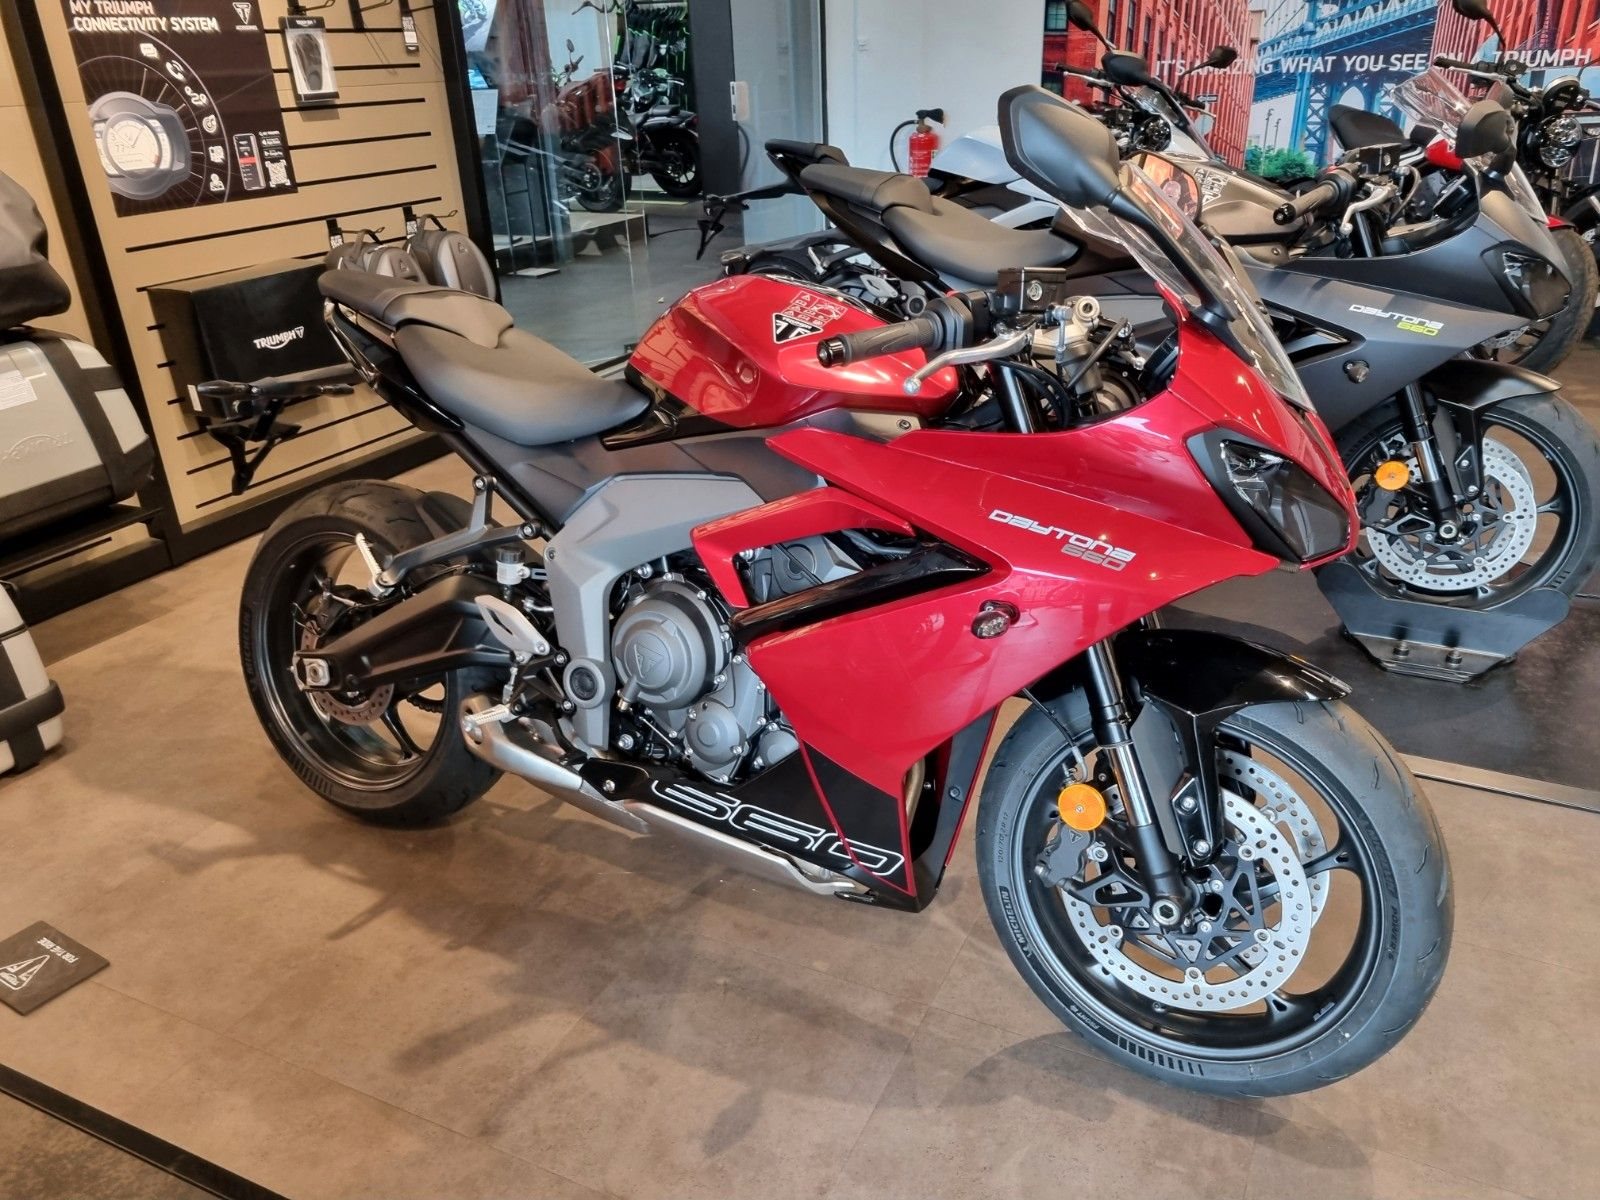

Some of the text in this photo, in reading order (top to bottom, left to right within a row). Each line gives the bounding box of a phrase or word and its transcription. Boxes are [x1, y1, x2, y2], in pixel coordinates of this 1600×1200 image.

[69, 0, 155, 15] MY TRIUMPH
[73, 17, 168, 31] CONNECTIVITY
[170, 17, 220, 31] SYSTEM
[1156, 60, 1185, 76] IT'S
[1281, 56, 1337, 74] WHAT
[1343, 54, 1384, 72] YOU
[1389, 53, 1428, 72] SEE
[253, 329, 297, 350] TRIUMPH
[1396, 320, 1439, 337] 660
[1061, 543, 1127, 572] 660
[651, 780, 905, 876] 660
[1001, 890, 1026, 944] MICHELIN
[1390, 905, 1399, 950] POWER
